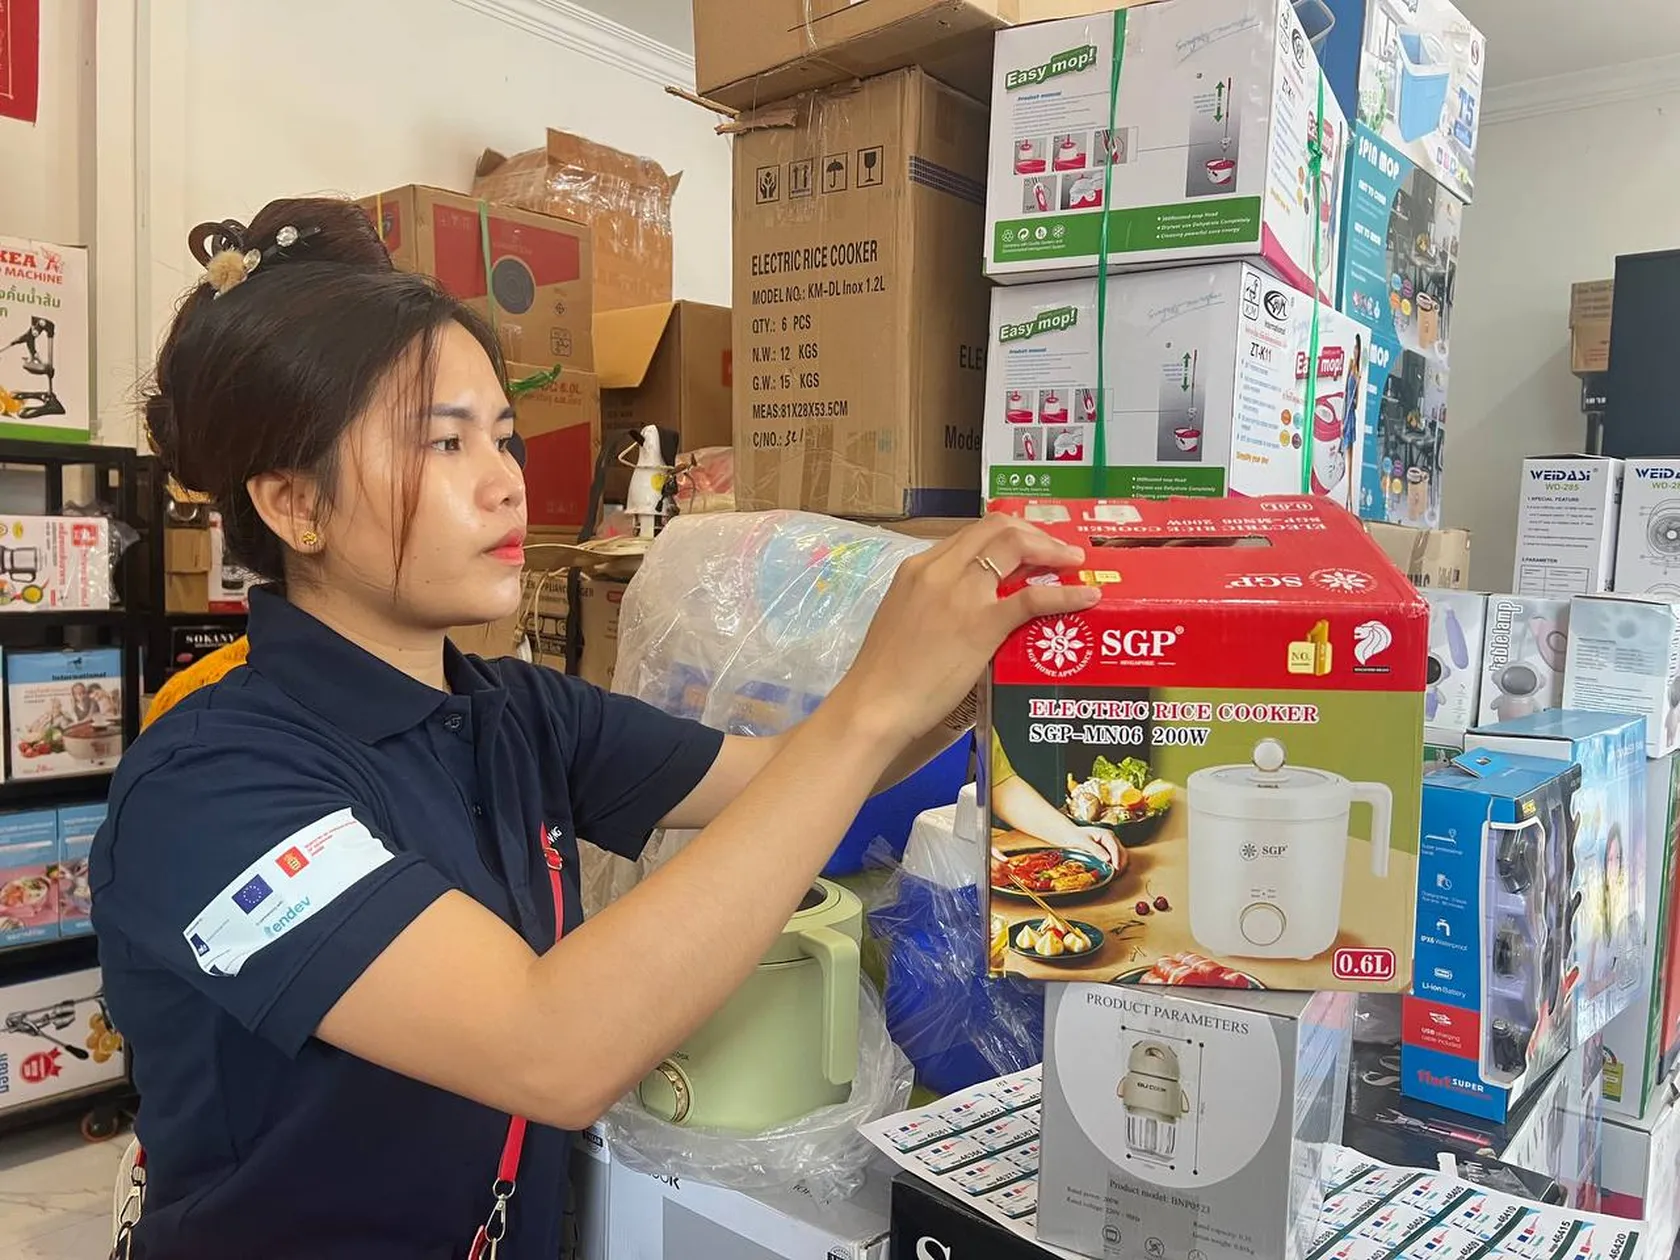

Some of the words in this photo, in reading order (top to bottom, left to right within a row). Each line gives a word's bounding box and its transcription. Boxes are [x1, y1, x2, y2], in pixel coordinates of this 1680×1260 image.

[1006, 64, 1046, 89] Easy
[1051, 46, 1096, 75] mop!
[1379, 150, 1400, 180] MOP
[752, 250, 800, 276] ELECTRIC
[804, 246, 828, 270] RICE
[830, 240, 878, 266] COOKER
[5, 266, 62, 284] MACHINE
[752, 288, 784, 305] MODEL
[808, 281, 840, 298] KM-DL
[843, 279, 863, 296] Inox
[866, 276, 885, 294] 1.2L
[781, 316, 787, 332] 6
[794, 314, 811, 332] PCS
[1000, 322, 1034, 340] Easy
[1038, 308, 1077, 330] mop!
[780, 346, 790, 361] 12
[799, 343, 818, 360] KGS
[1250, 342, 1272, 363] ZT-K11
[1321, 353, 1344, 376] mop!
[780, 375, 791, 389] 15
[800, 372, 820, 389] KGS
[1222, 524, 1326, 532] ELECTRIC
[1230, 576, 1303, 588] SGP
[1101, 630, 1176, 657] SGP
[1058, 649, 1093, 678] APPLIANCE
[1030, 700, 1149, 721] ELECTRIC
[1152, 702, 1211, 721] RICE
[1218, 704, 1318, 724] COOKER
[1030, 724, 1143, 745] SGP-MN06
[1152, 726, 1209, 746] 200W
[1262, 846, 1286, 855] SGP
[272, 896, 311, 935] endev
[1339, 954, 1389, 974] 0.6L
[1442, 986, 1466, 998] Battery
[1086, 993, 1151, 1016] PRODUCT
[1154, 1006, 1249, 1034] PARAMETERS
[1452, 1078, 1484, 1092] SUPER
[1110, 1179, 1139, 1194] Product
[1552, 1221, 1571, 1242] 46415
[1608, 1233, 1626, 1260] 46420
